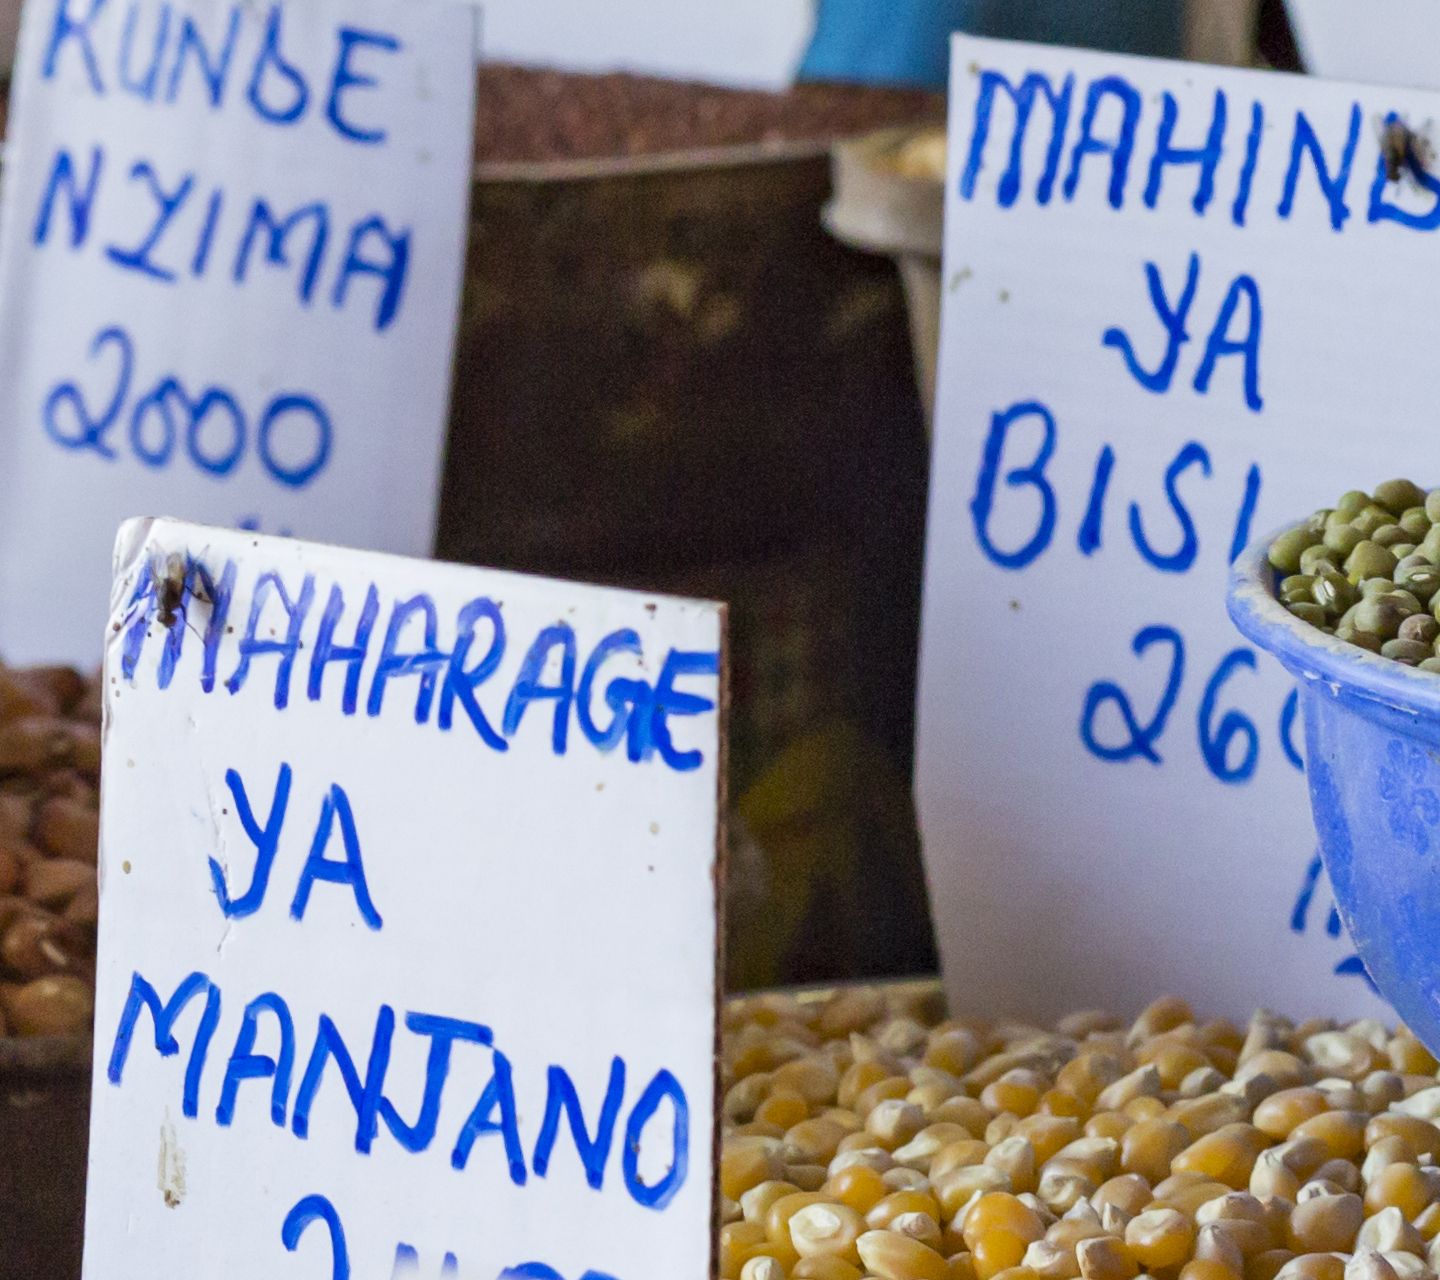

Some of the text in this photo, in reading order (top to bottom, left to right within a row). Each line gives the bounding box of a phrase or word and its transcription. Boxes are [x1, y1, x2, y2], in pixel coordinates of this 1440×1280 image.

[33, 144, 411, 333] NZIMA
[42, 323, 333, 490] 2000
[1102, 252, 1264, 413] YA
[969, 398, 1262, 571] BISI
[120, 549, 720, 773] MAHARAGE
[208, 761, 384, 932] YA
[109, 970, 690, 1213] MANJANO
